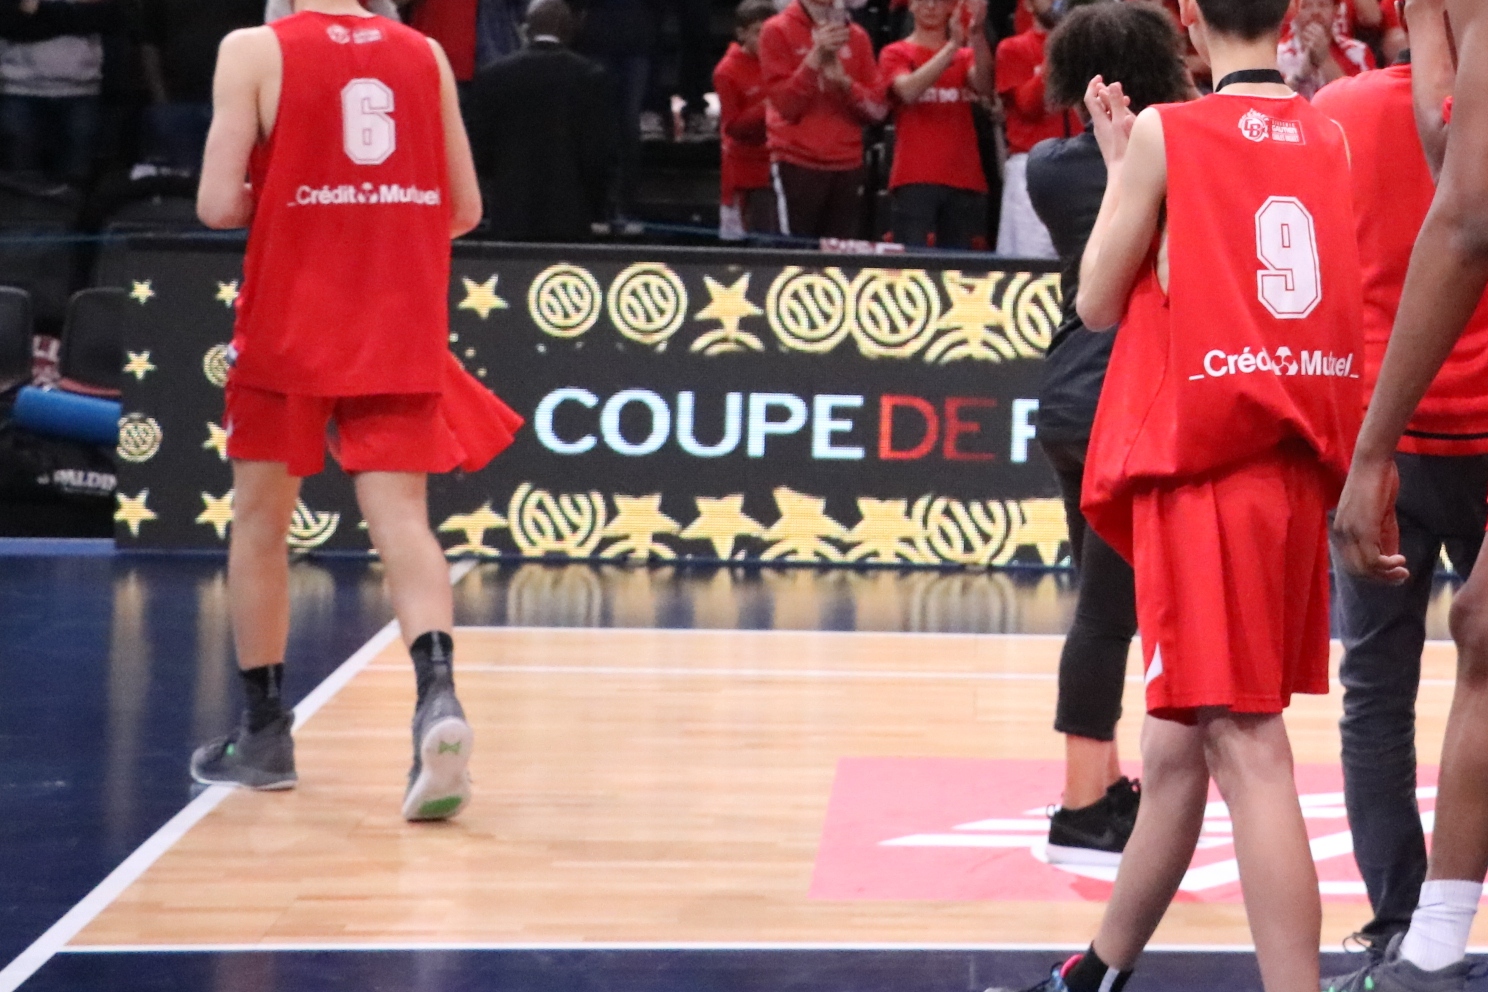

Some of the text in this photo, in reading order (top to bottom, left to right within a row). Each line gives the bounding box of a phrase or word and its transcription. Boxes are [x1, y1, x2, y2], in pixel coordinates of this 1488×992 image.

[341, 78, 396, 165] 6
[1255, 196, 1322, 319] 9
[534, 386, 865, 459] COUPE
[878, 394, 996, 461] DE
